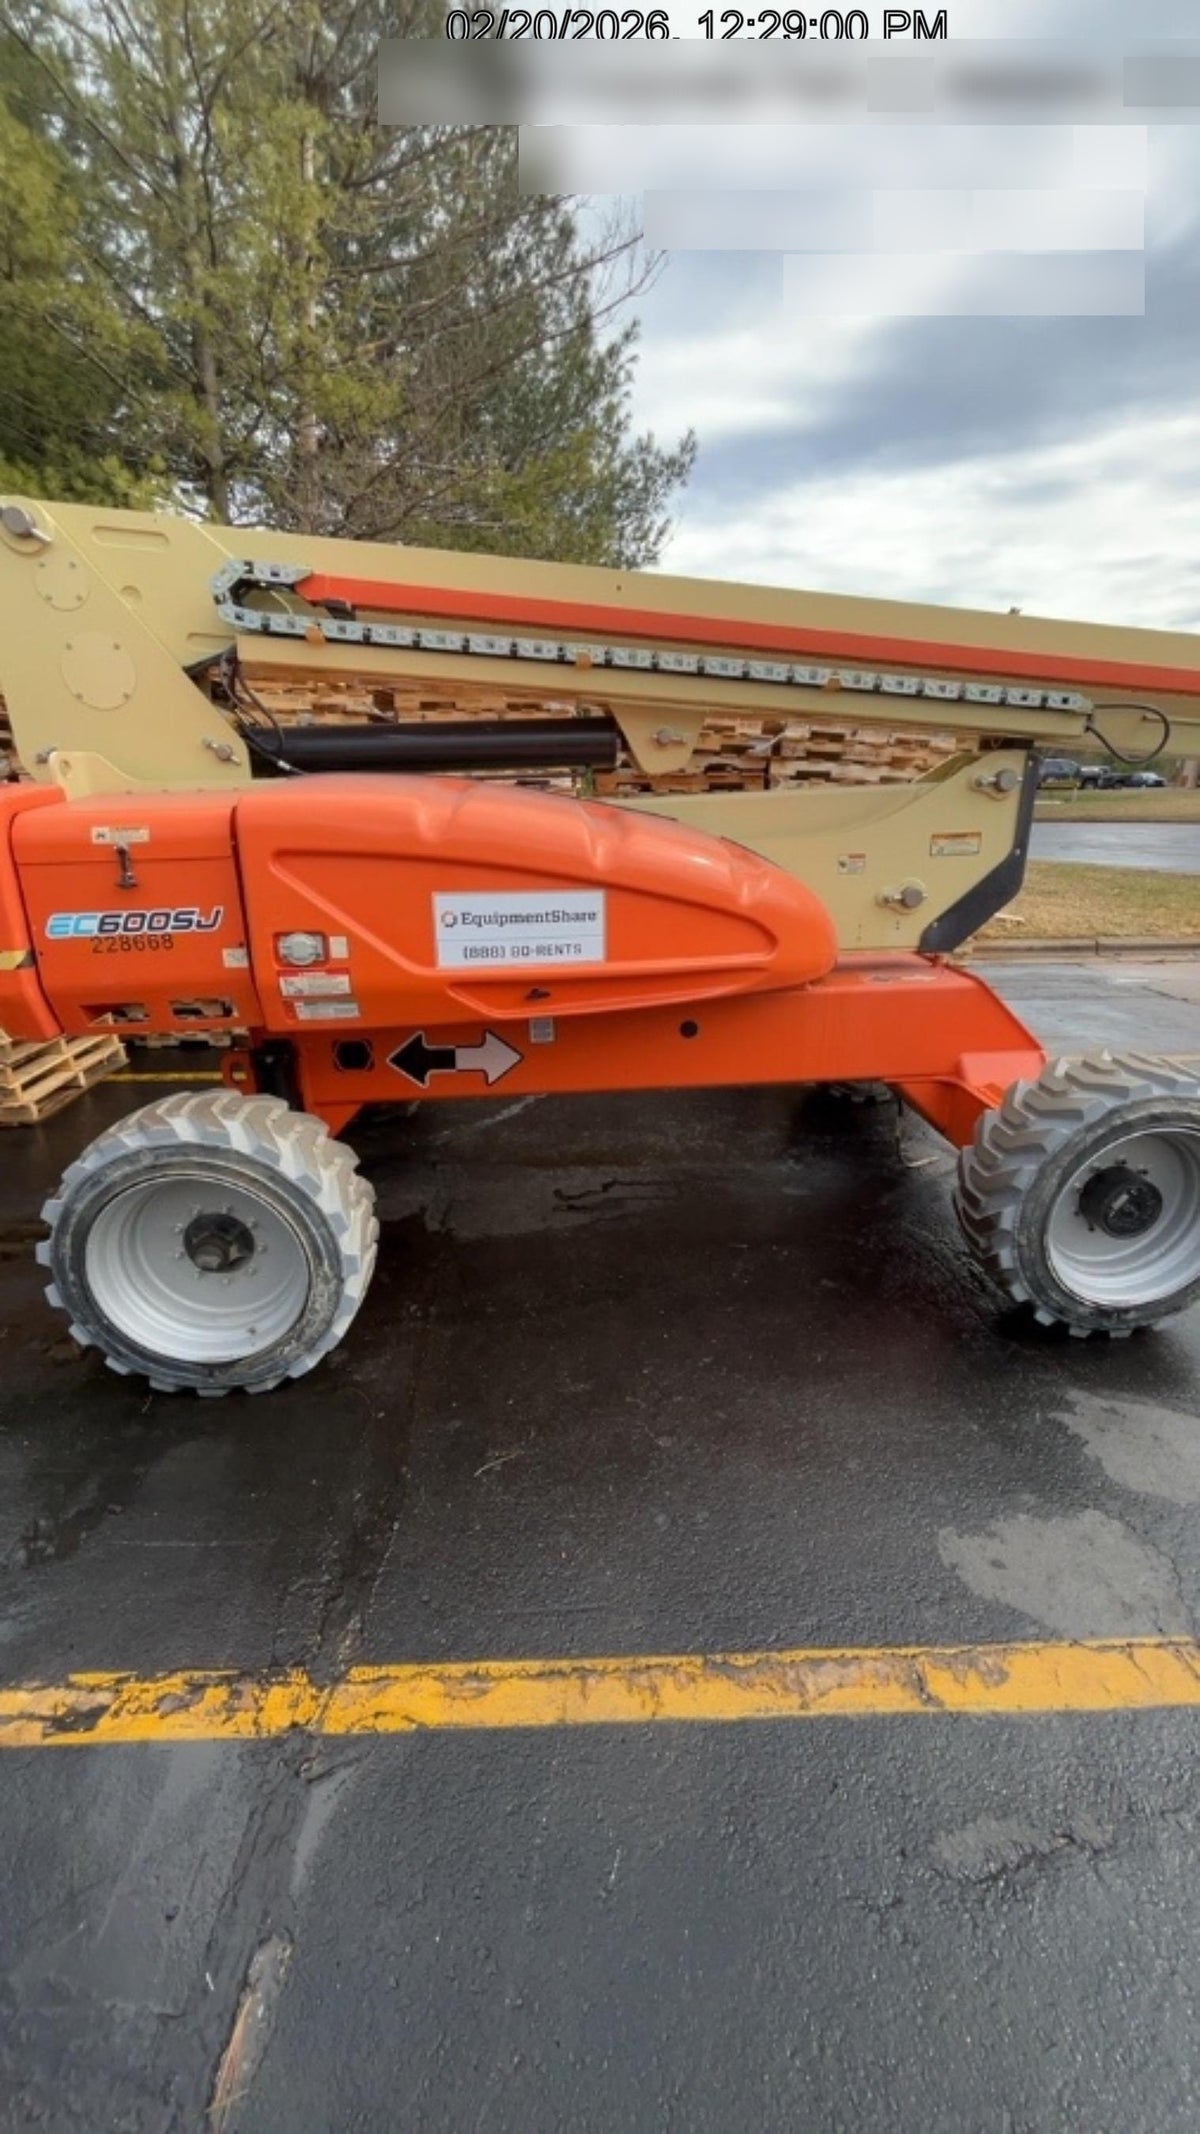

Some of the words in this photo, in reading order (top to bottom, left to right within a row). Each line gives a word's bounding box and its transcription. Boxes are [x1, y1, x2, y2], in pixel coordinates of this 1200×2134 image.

[48, 909, 221, 935] EC600SJ
[461, 910, 597, 928] EquipmentShare
[90, 933, 174, 954] 228668
[463, 945, 506, 960] (888)
[511, 943, 582, 958] 80-RENTS
